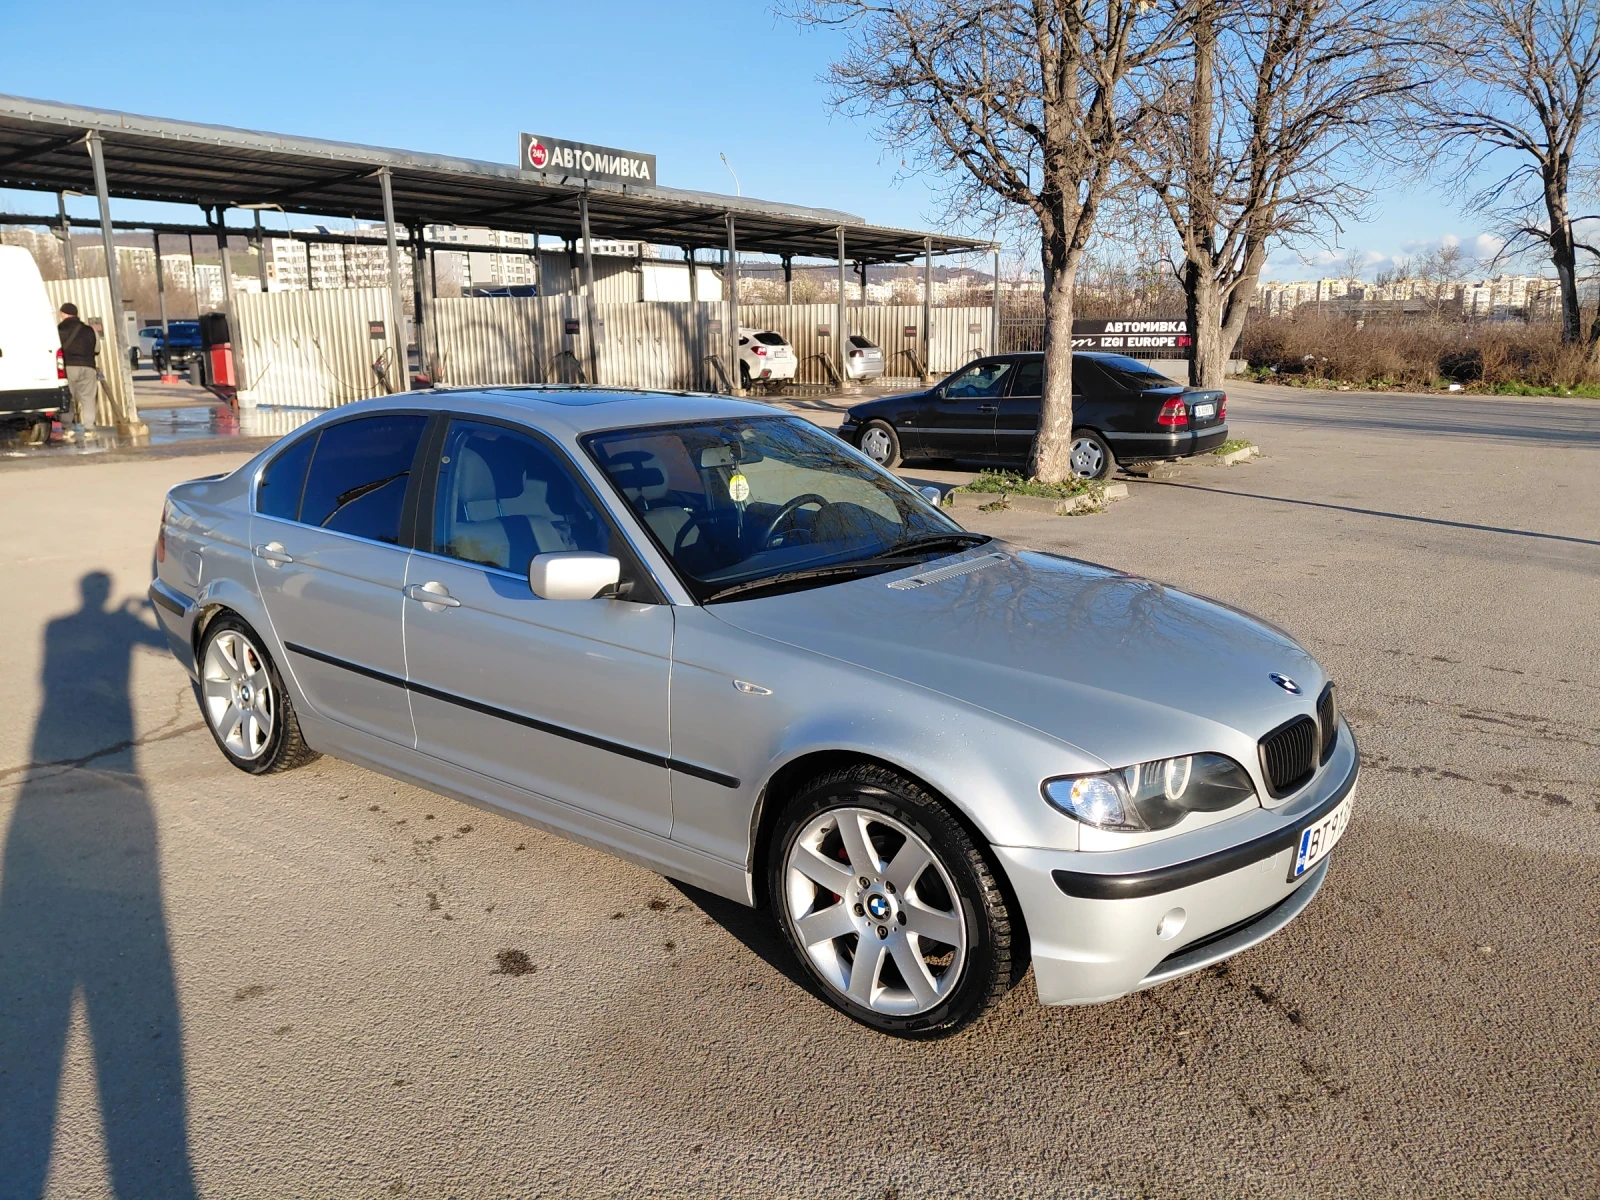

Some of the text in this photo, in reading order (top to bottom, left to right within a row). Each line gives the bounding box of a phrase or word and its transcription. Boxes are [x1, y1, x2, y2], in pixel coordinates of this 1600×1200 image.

[551, 147, 650, 180] АВТОМИВКА
[1105, 321, 1187, 333] АВТОМИВКА
[1101, 336, 1124, 347] IZGI
[1127, 336, 1176, 347] EUROPE
